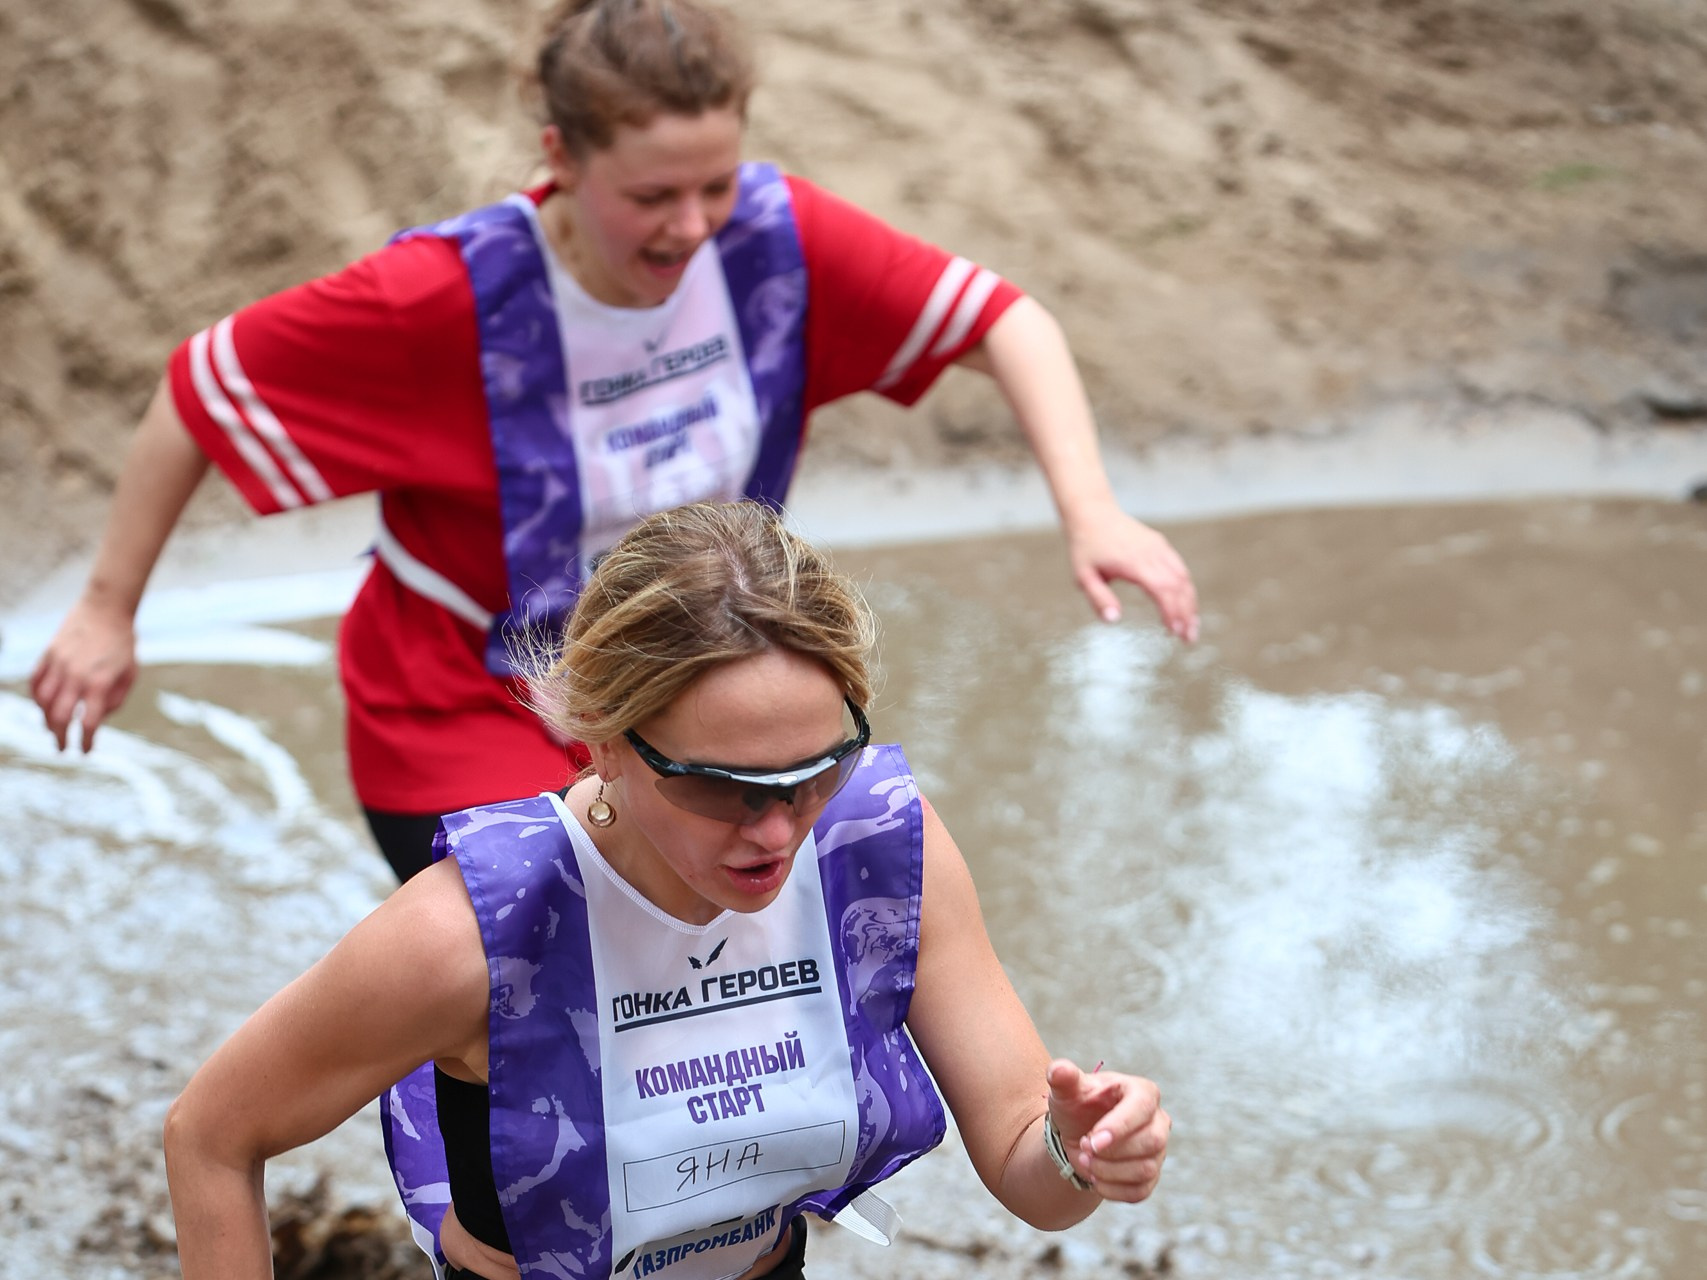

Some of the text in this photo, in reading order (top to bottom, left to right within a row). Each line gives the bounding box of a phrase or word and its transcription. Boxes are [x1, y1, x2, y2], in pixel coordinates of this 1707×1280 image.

[612, 959, 820, 1022] ГОНКА ГЕРОЕВ
[635, 1030, 806, 1099] КОМАНДНЫЙ
[687, 1084, 766, 1125] СТАРТ
[676, 1142, 764, 1192] ЯНА
[633, 1208, 778, 1280] ГАЗПРОМБАНК
